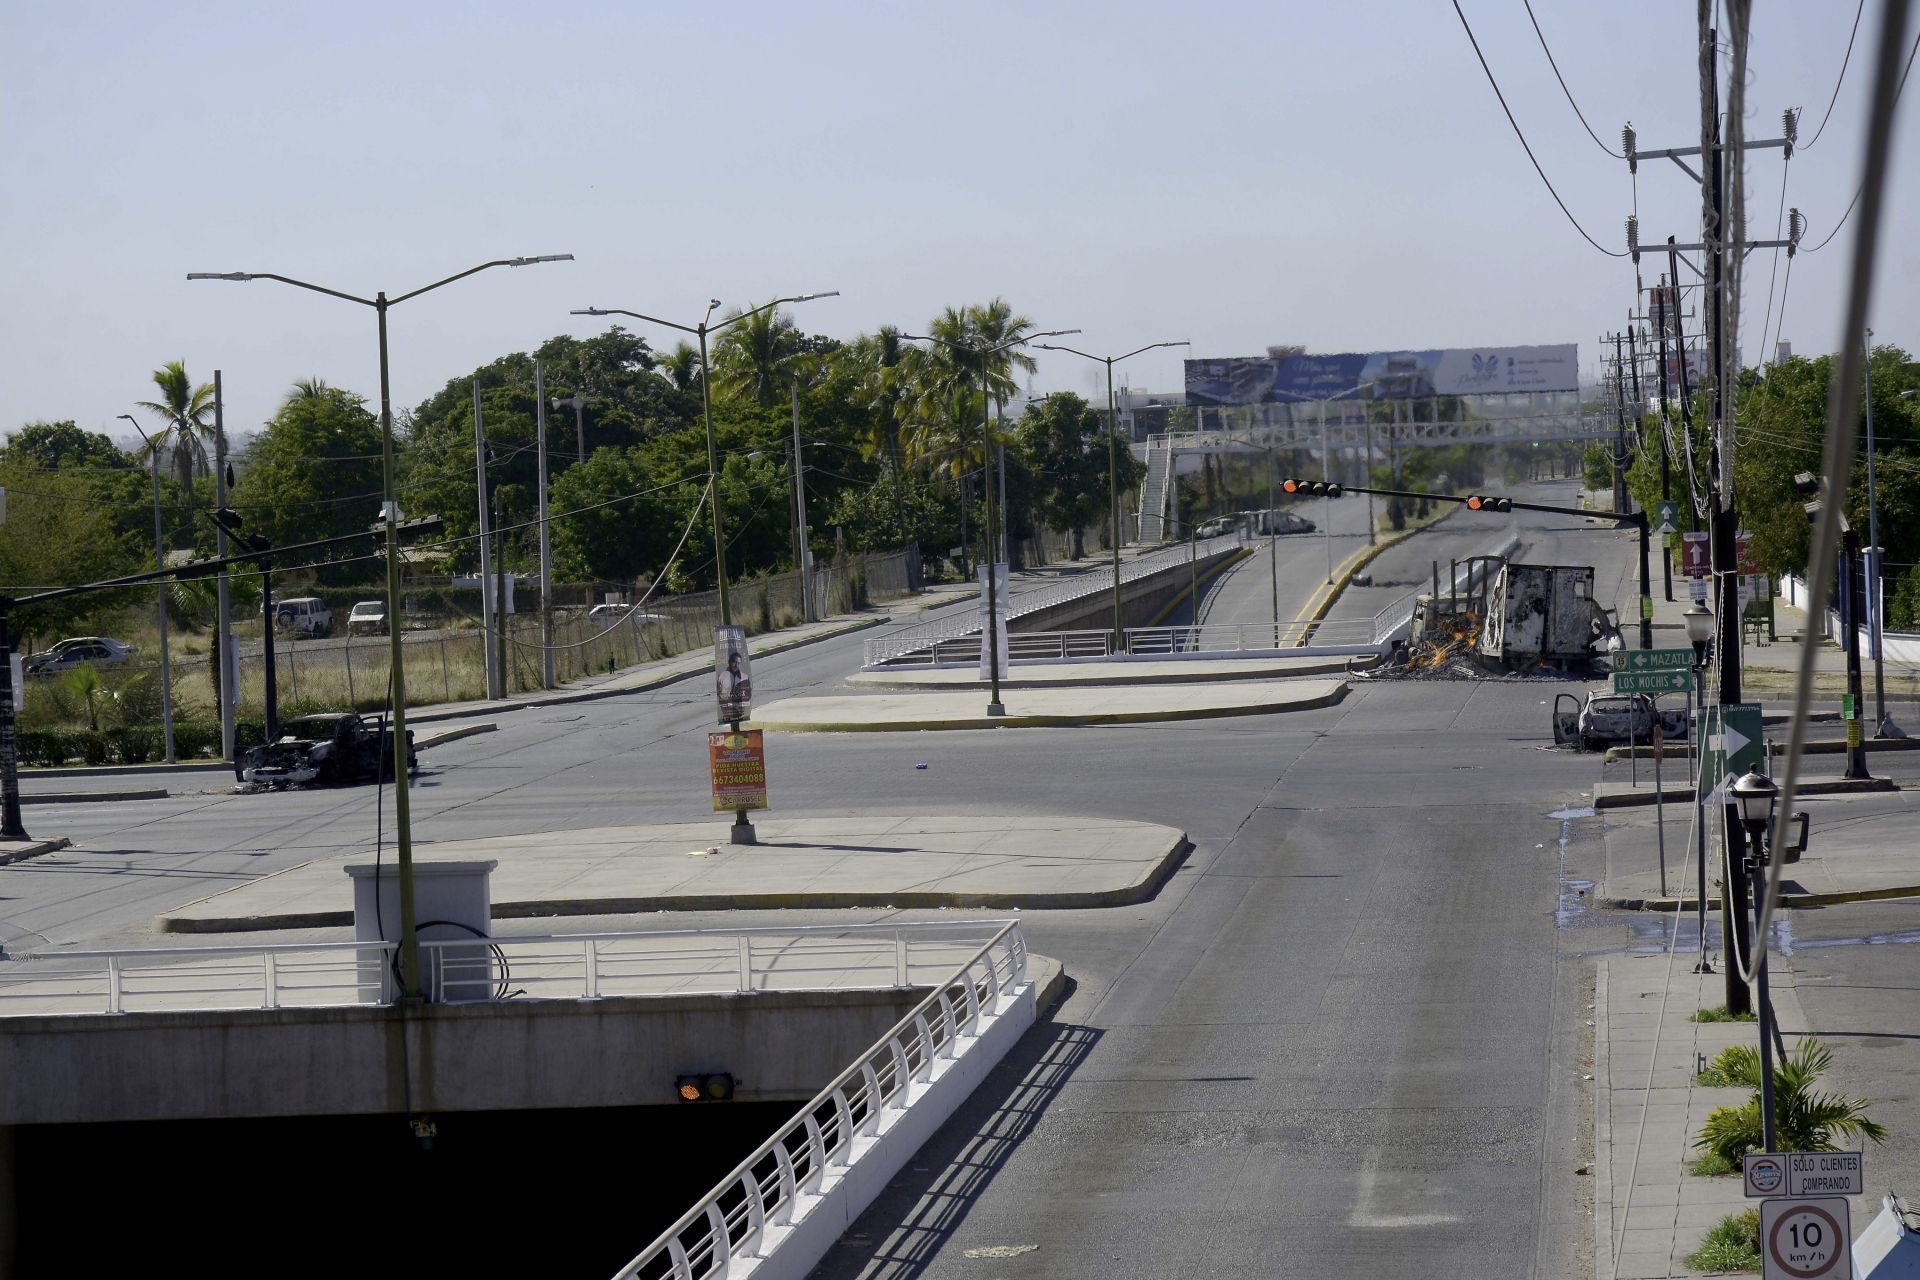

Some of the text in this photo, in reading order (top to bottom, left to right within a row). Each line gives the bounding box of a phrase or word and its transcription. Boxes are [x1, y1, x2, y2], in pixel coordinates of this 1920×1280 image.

[1617, 657, 1625, 666] 15
[1650, 652, 1697, 666] MAZATLA
[1618, 675, 1669, 689] LOS MOCHIS
[714, 773, 764, 785] 6673404088
[1820, 1157, 1858, 1171] CLIENTES
[1802, 1177, 1850, 1190] COMPRANDO
[1790, 1223, 1823, 1248] 10
[1789, 1252, 1825, 1262] km/h
